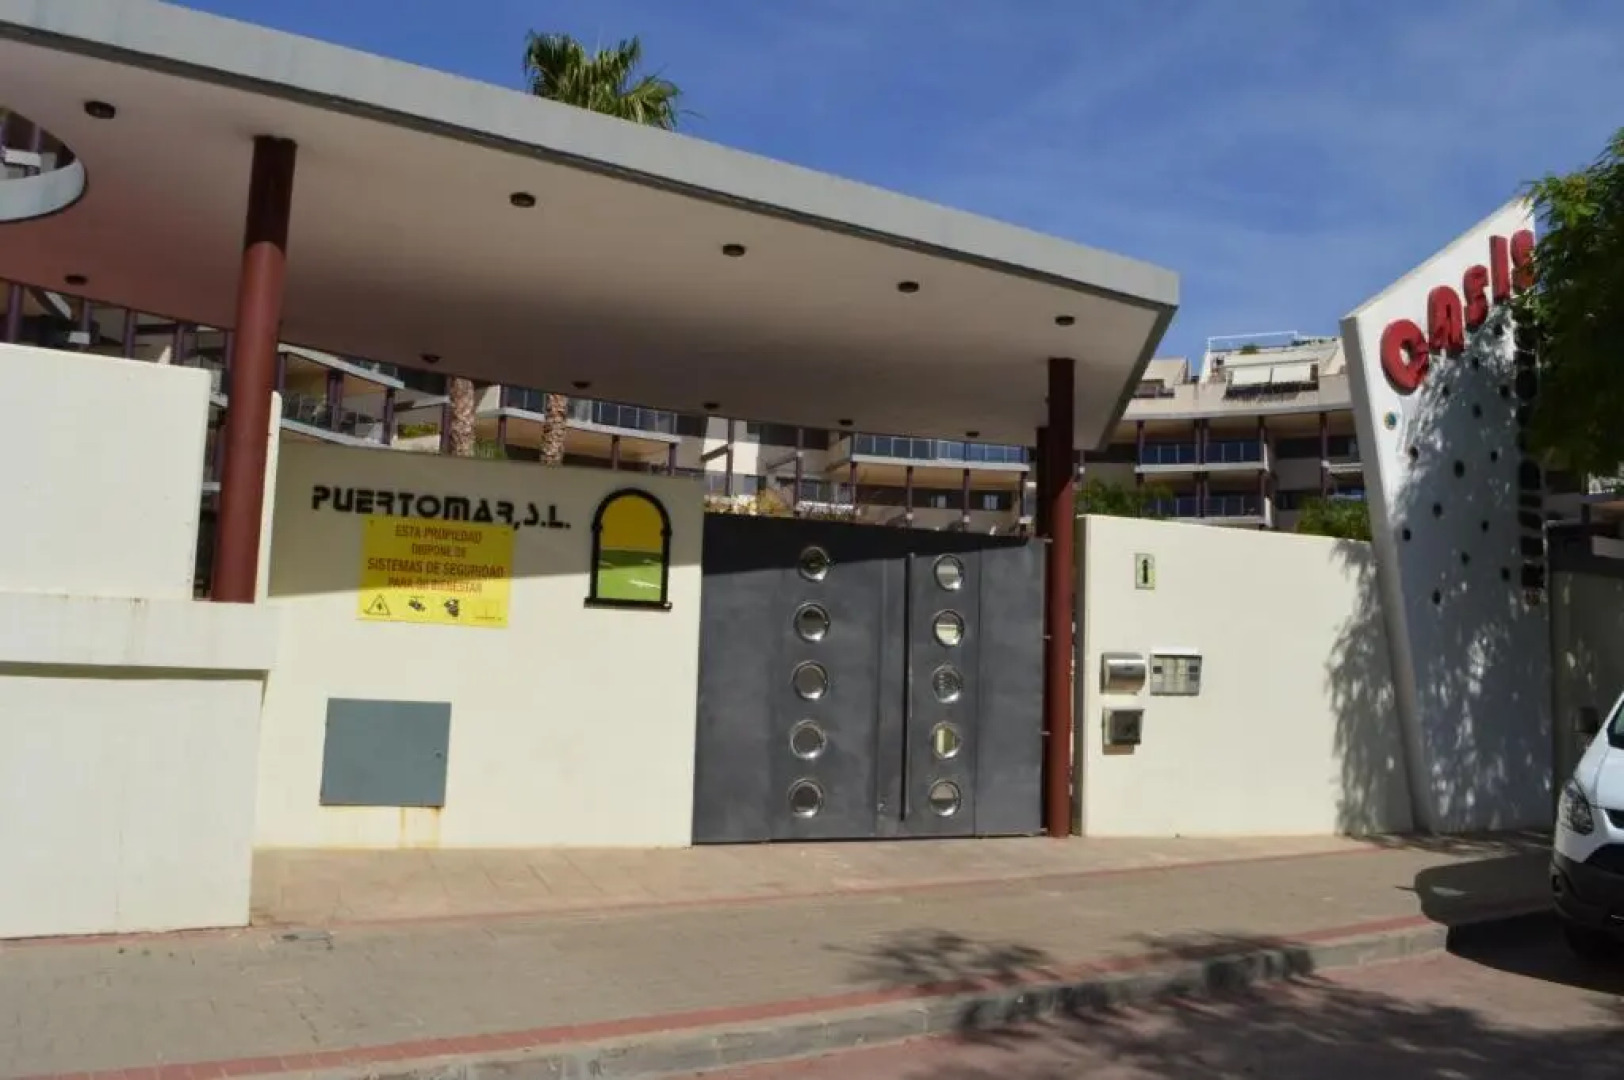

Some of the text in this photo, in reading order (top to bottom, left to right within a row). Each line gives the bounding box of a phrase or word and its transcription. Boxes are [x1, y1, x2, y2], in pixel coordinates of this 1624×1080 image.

[394, 525, 421, 540] ESTA
[367, 557, 505, 578] SISTEMAS DE SEGURIDAD
